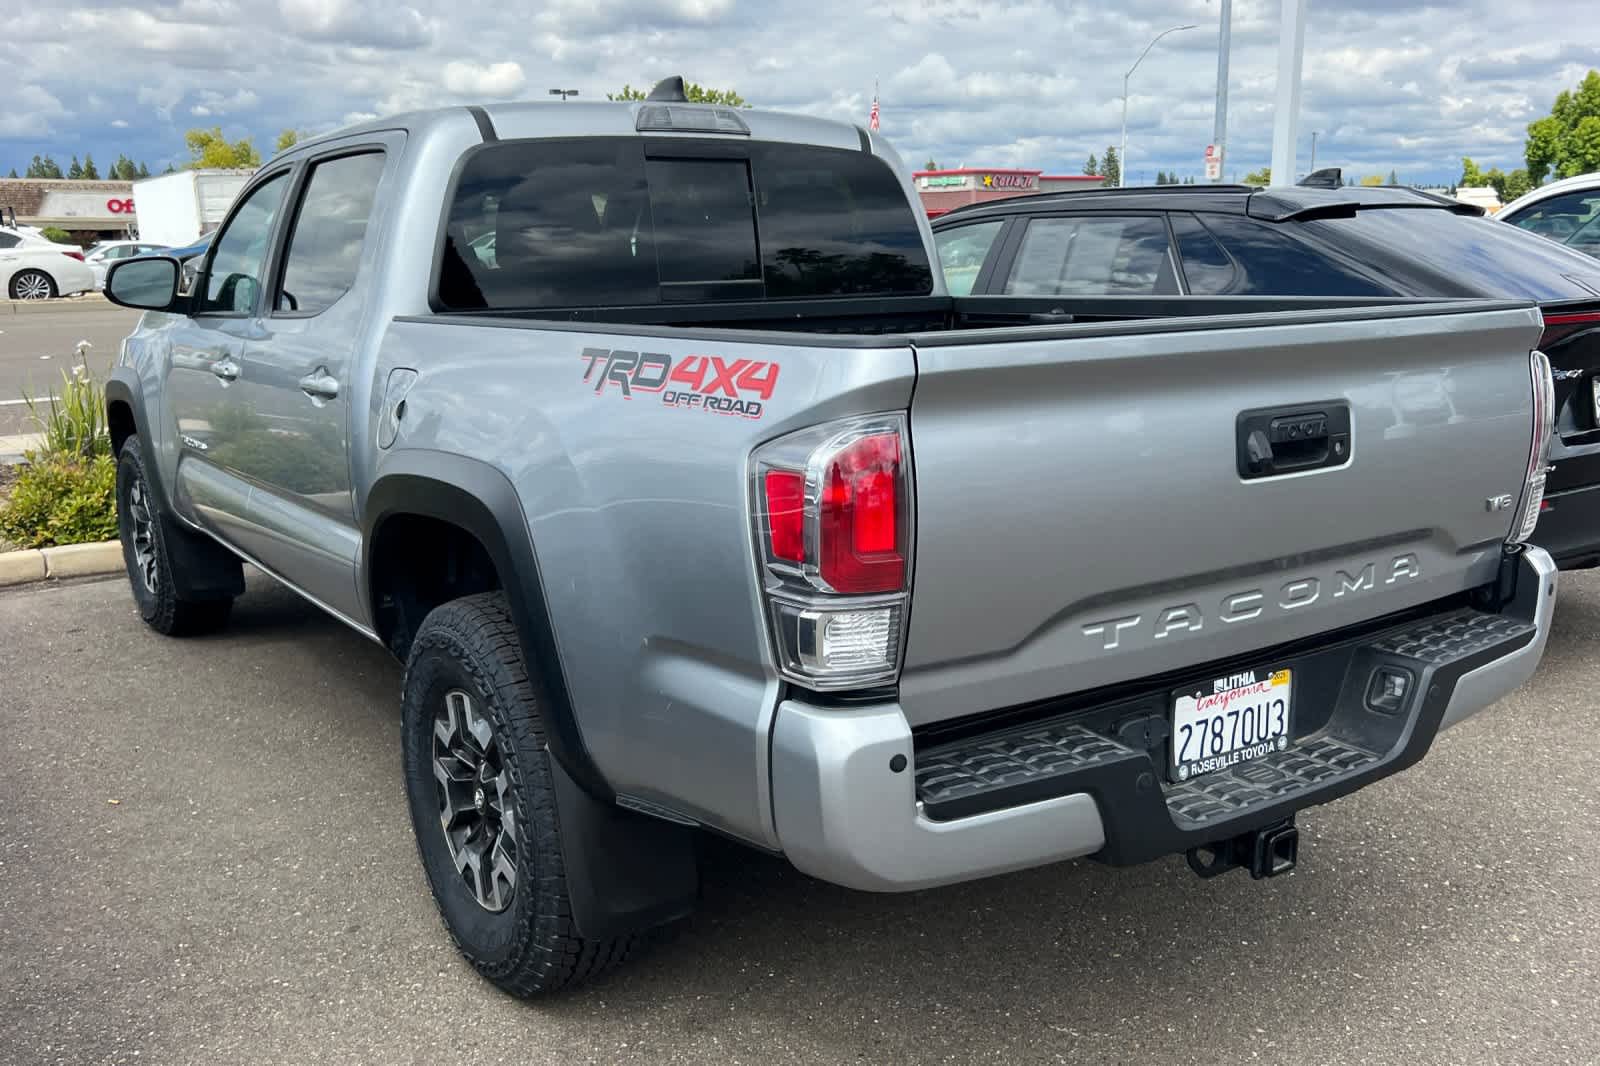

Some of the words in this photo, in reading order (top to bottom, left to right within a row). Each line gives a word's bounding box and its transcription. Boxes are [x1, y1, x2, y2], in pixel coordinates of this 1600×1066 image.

[581, 347, 672, 400] TRD
[662, 390, 701, 408] OFF
[702, 396, 764, 419] ROAD
[1081, 552, 1420, 649] TACOMA
[1195, 682, 1271, 712] California
[1223, 670, 1256, 691] LITHIA
[1178, 698, 1285, 765] 27870U3
[1191, 751, 1240, 776] ROSEVILLE
[1241, 741, 1275, 761] TOYOTA
